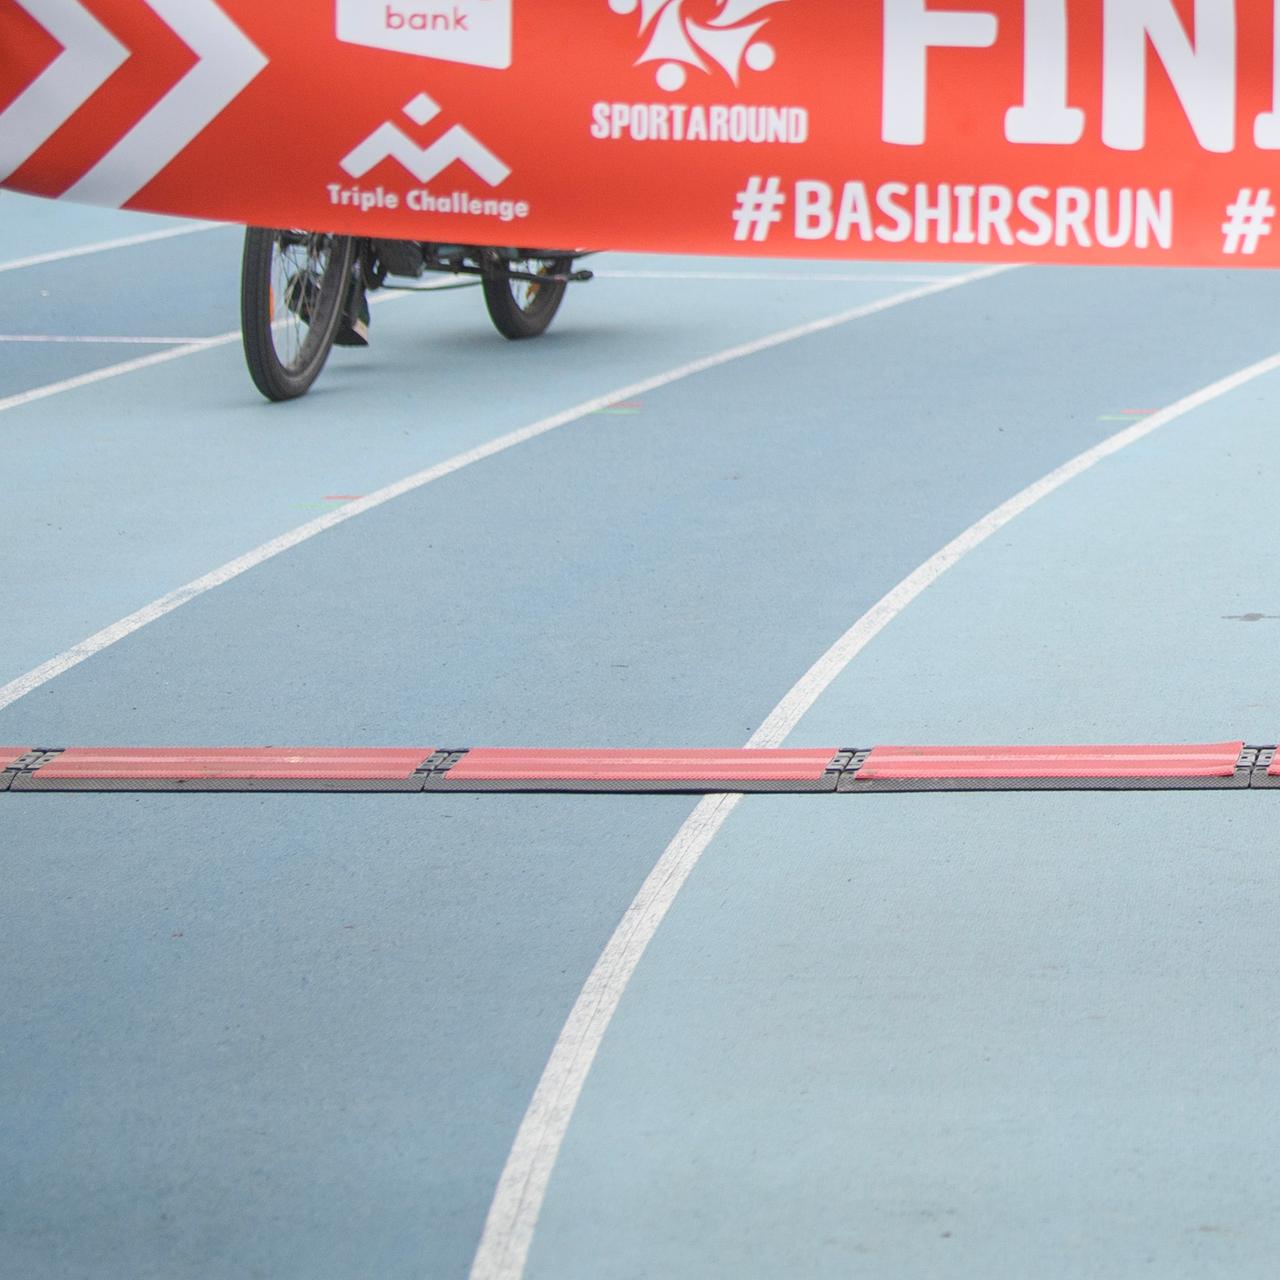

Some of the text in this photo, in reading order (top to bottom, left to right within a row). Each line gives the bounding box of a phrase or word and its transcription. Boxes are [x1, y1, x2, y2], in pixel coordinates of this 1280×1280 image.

[385, 4, 468, 32] bank
[590, 101, 809, 144] SPORTAROUND
[327, 183, 529, 222] Triple Challenge
